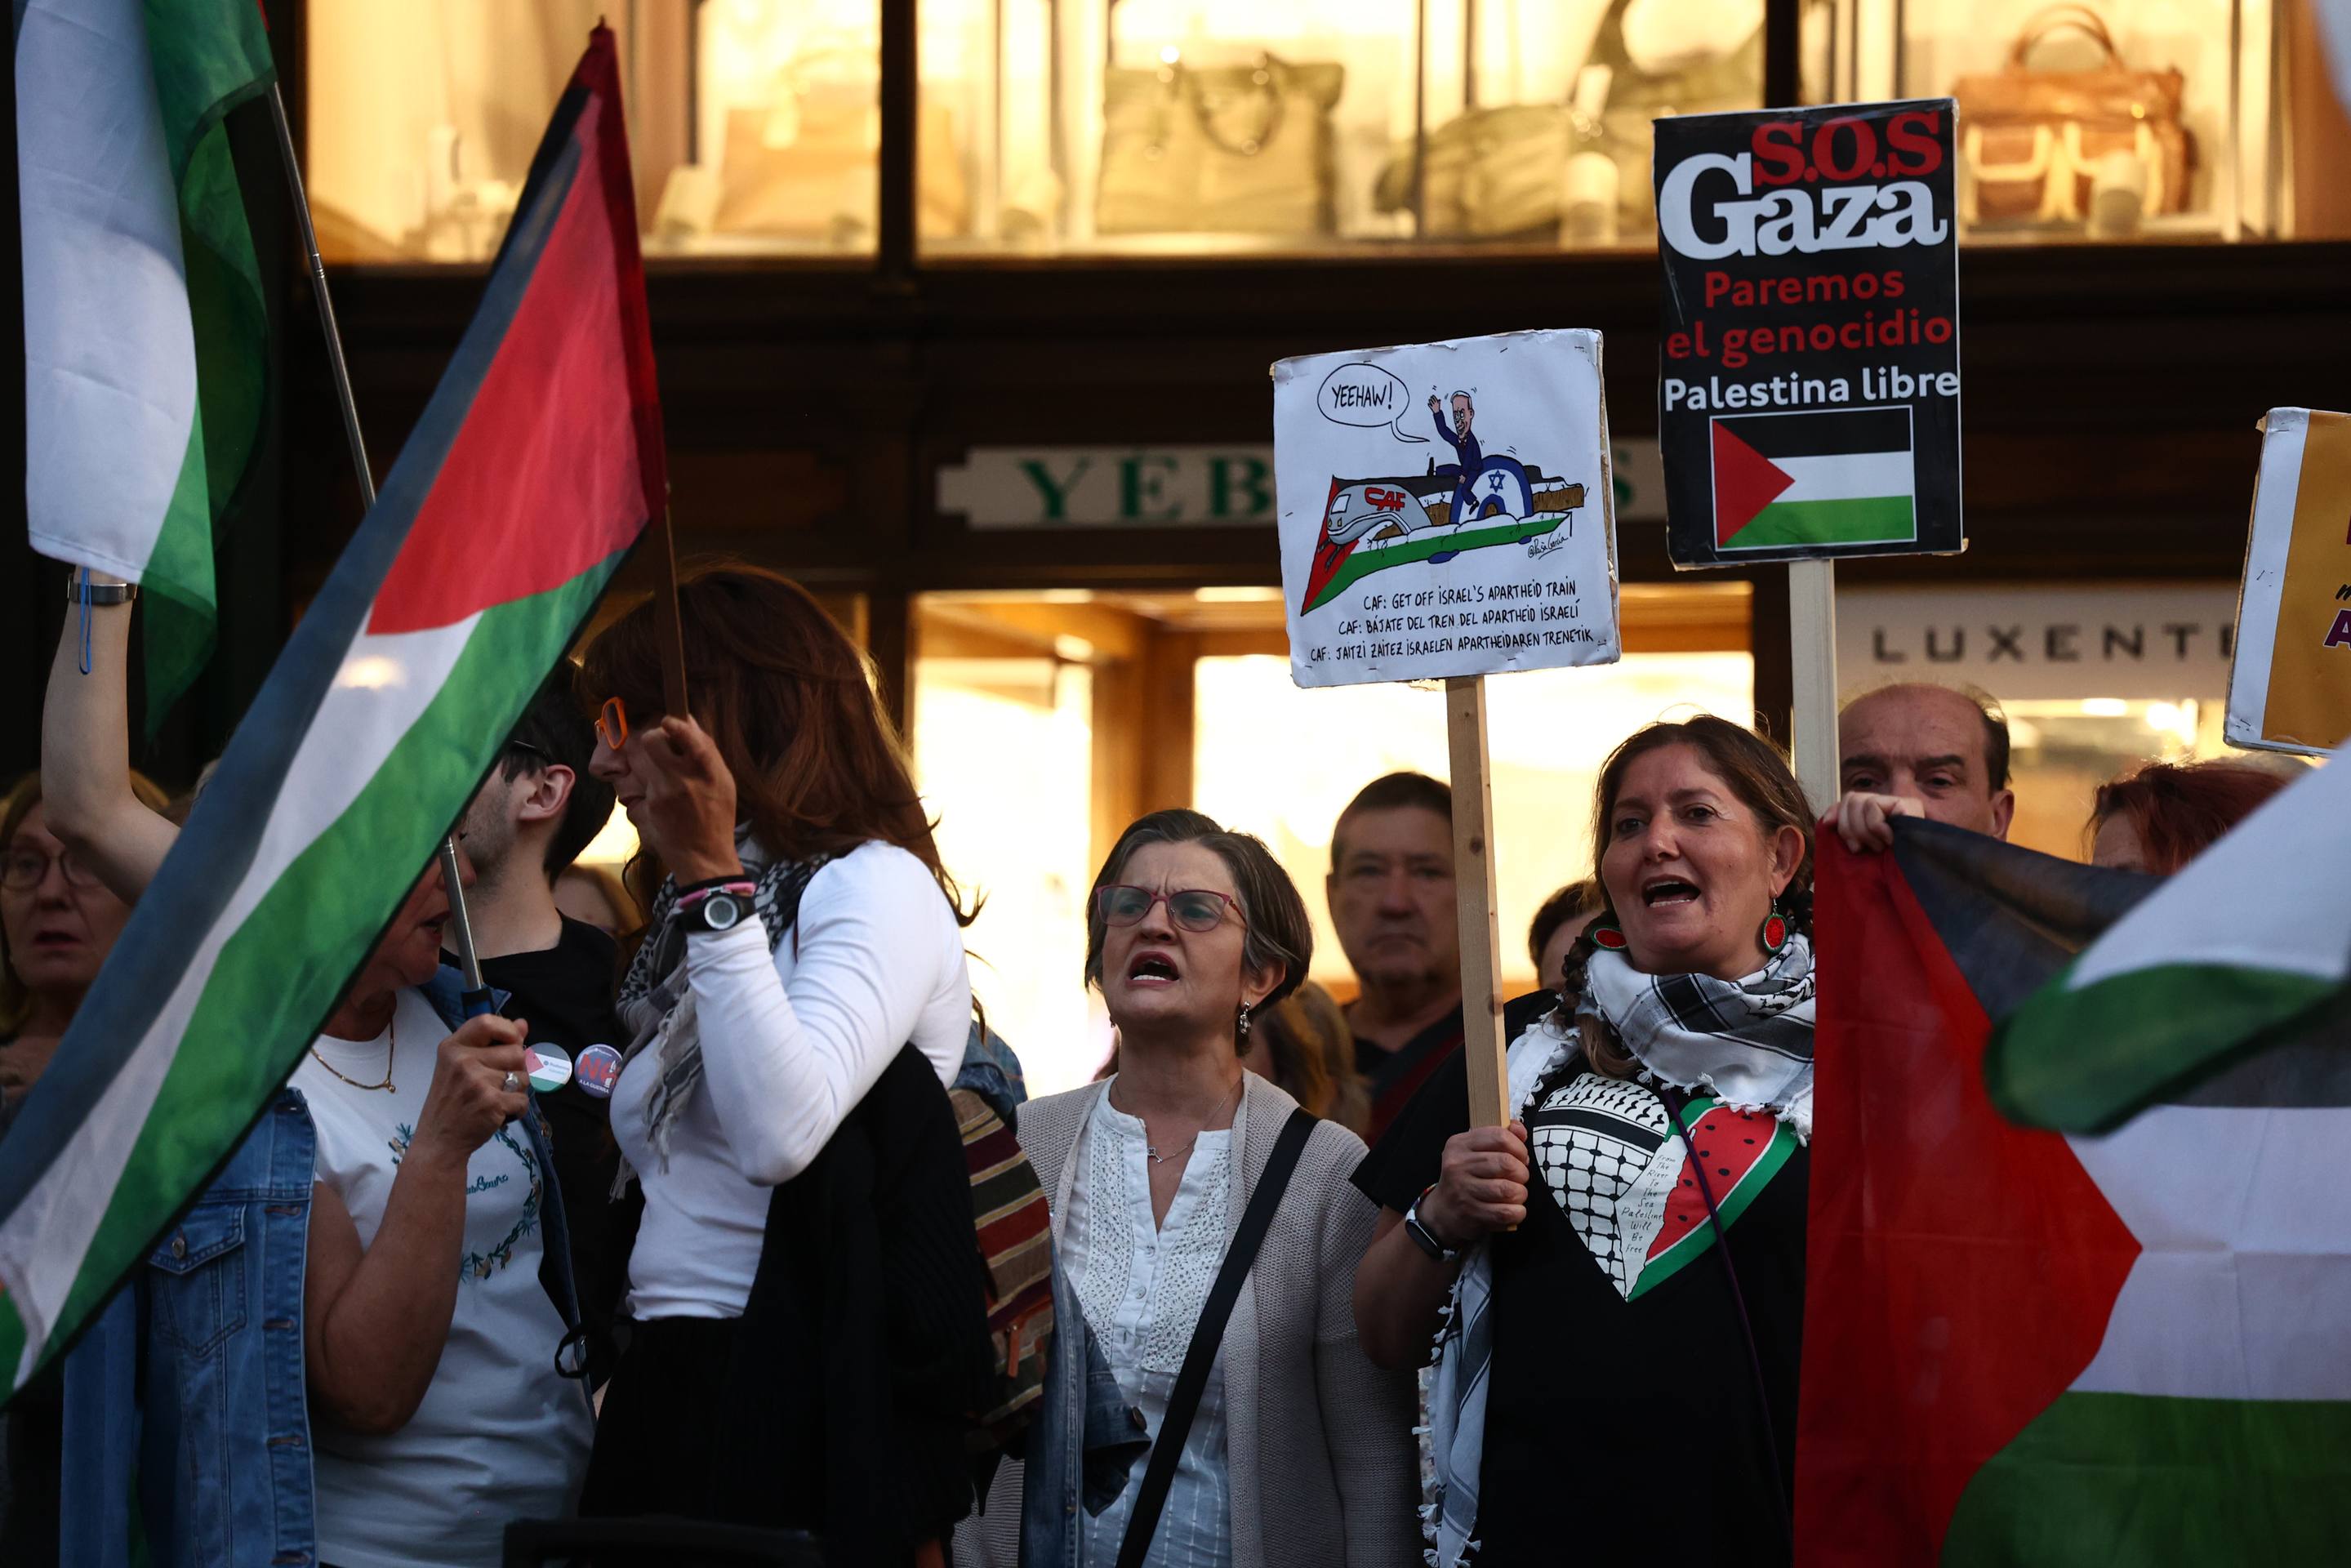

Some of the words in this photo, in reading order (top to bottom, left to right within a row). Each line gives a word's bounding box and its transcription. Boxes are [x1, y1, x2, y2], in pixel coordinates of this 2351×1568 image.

[1751, 109, 1943, 187] S.O.S
[1659, 152, 1948, 261] Gaza
[1705, 270, 1905, 308] Paremos
[1666, 321, 1710, 359] el
[1721, 309, 1952, 368] genocidio
[1332, 381, 1393, 410] YEEHAW!
[1665, 372, 1850, 412] Palestina
[1862, 366, 1961, 401] libre
[1365, 487, 1406, 511] CAF
[1364, 595, 1387, 611] CAF:
[1392, 593, 1412, 609] GET
[1414, 590, 1434, 607] OFF
[1338, 620, 1362, 635] CAF:
[1366, 615, 1404, 635] BÁJATE
[1407, 616, 1426, 630] DEL
[1428, 613, 1455, 629] TREN
[1459, 612, 1479, 626] DEL
[1311, 646, 1331, 662] CAF:
[1656, 1161, 1669, 1169] The
[1638, 1197, 1654, 1208] Sea
[1643, 1187, 1658, 1197] The
[1621, 1207, 1663, 1220] Palestine
[1631, 1221, 1651, 1231] Will
[1632, 1232, 1643, 1241] Be
